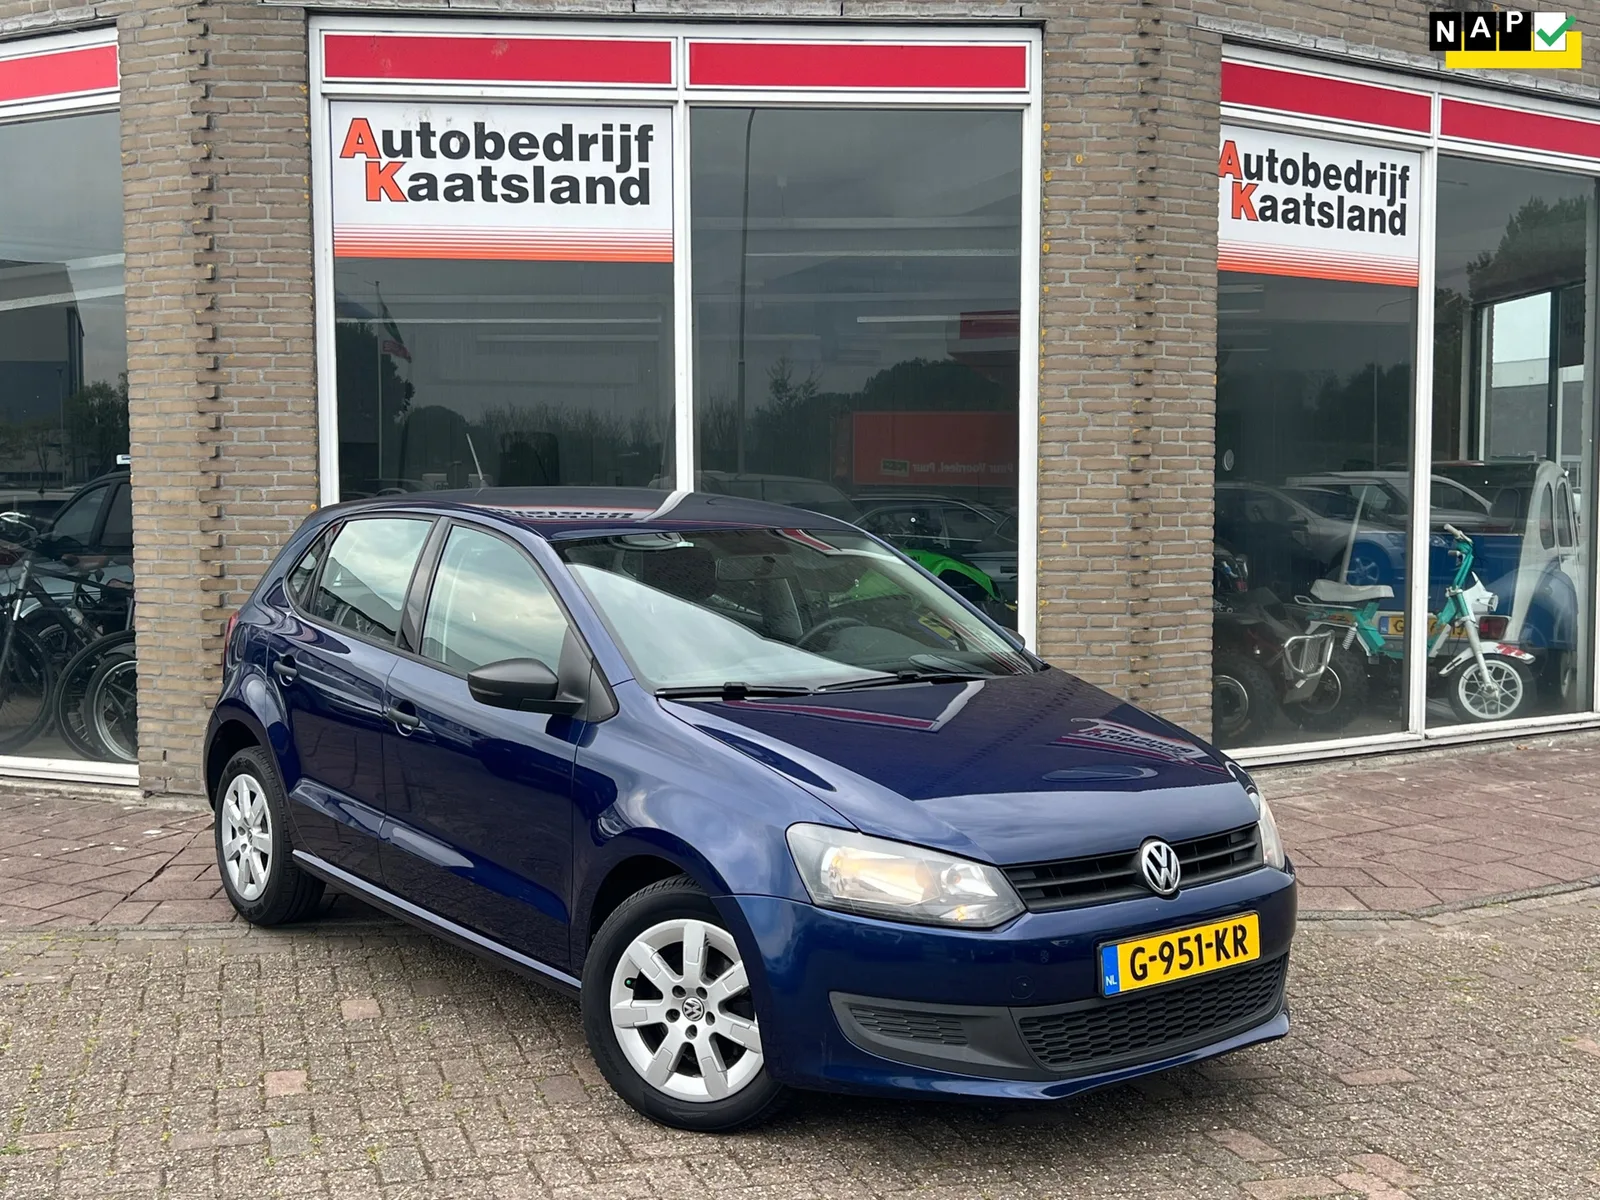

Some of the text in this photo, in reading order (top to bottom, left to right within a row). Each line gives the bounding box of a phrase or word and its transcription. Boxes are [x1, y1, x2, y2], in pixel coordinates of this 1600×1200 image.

[339, 117, 654, 173] Autobedrijf
[365, 160, 650, 206] Kaatsland
[1218, 140, 1410, 206] Autobedrijf
[1231, 181, 1407, 236] Kaatsland
[1105, 974, 1117, 986] NL
[1130, 924, 1248, 981] G-951-KR
